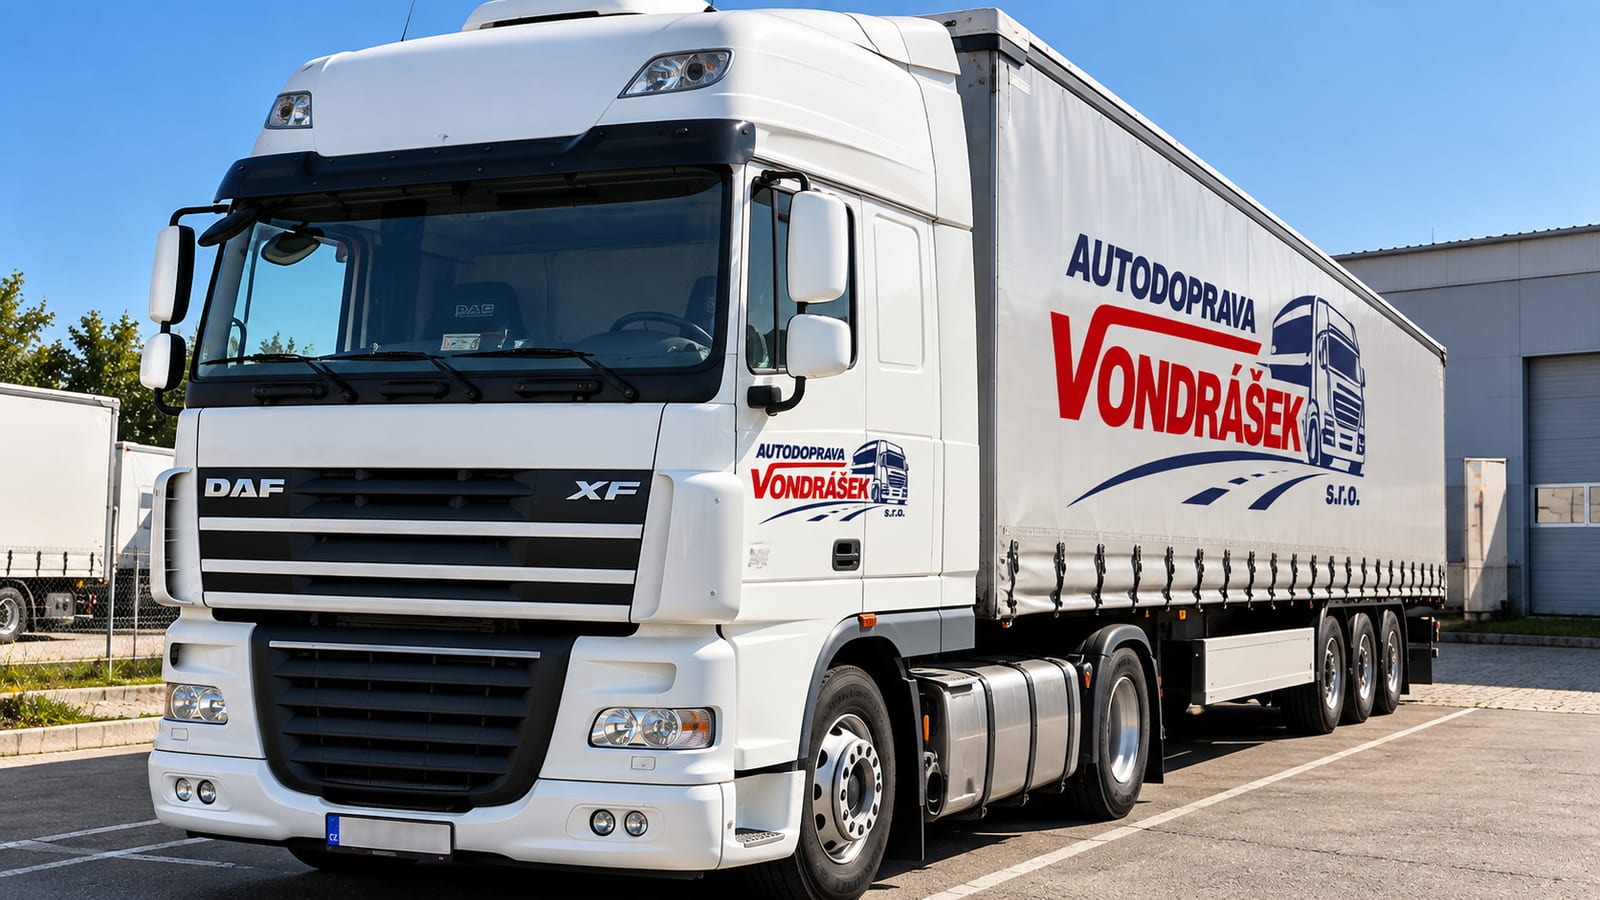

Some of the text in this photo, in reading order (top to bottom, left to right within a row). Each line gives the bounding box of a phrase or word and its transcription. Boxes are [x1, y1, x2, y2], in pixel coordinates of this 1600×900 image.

[1066, 233, 1256, 334] AUTODOPRAVA
[1050, 304, 1305, 452] VONDRÁŠEK
[756, 443, 845, 461] AUTODOPRAVA
[204, 478, 285, 498] DAF
[565, 480, 641, 501] XF
[750, 462, 871, 500] VONDRÁŠEK
[1325, 483, 1360, 506] s.r.o.
[884, 507, 905, 518] s.r.o.
[329, 833, 338, 842] CZ
